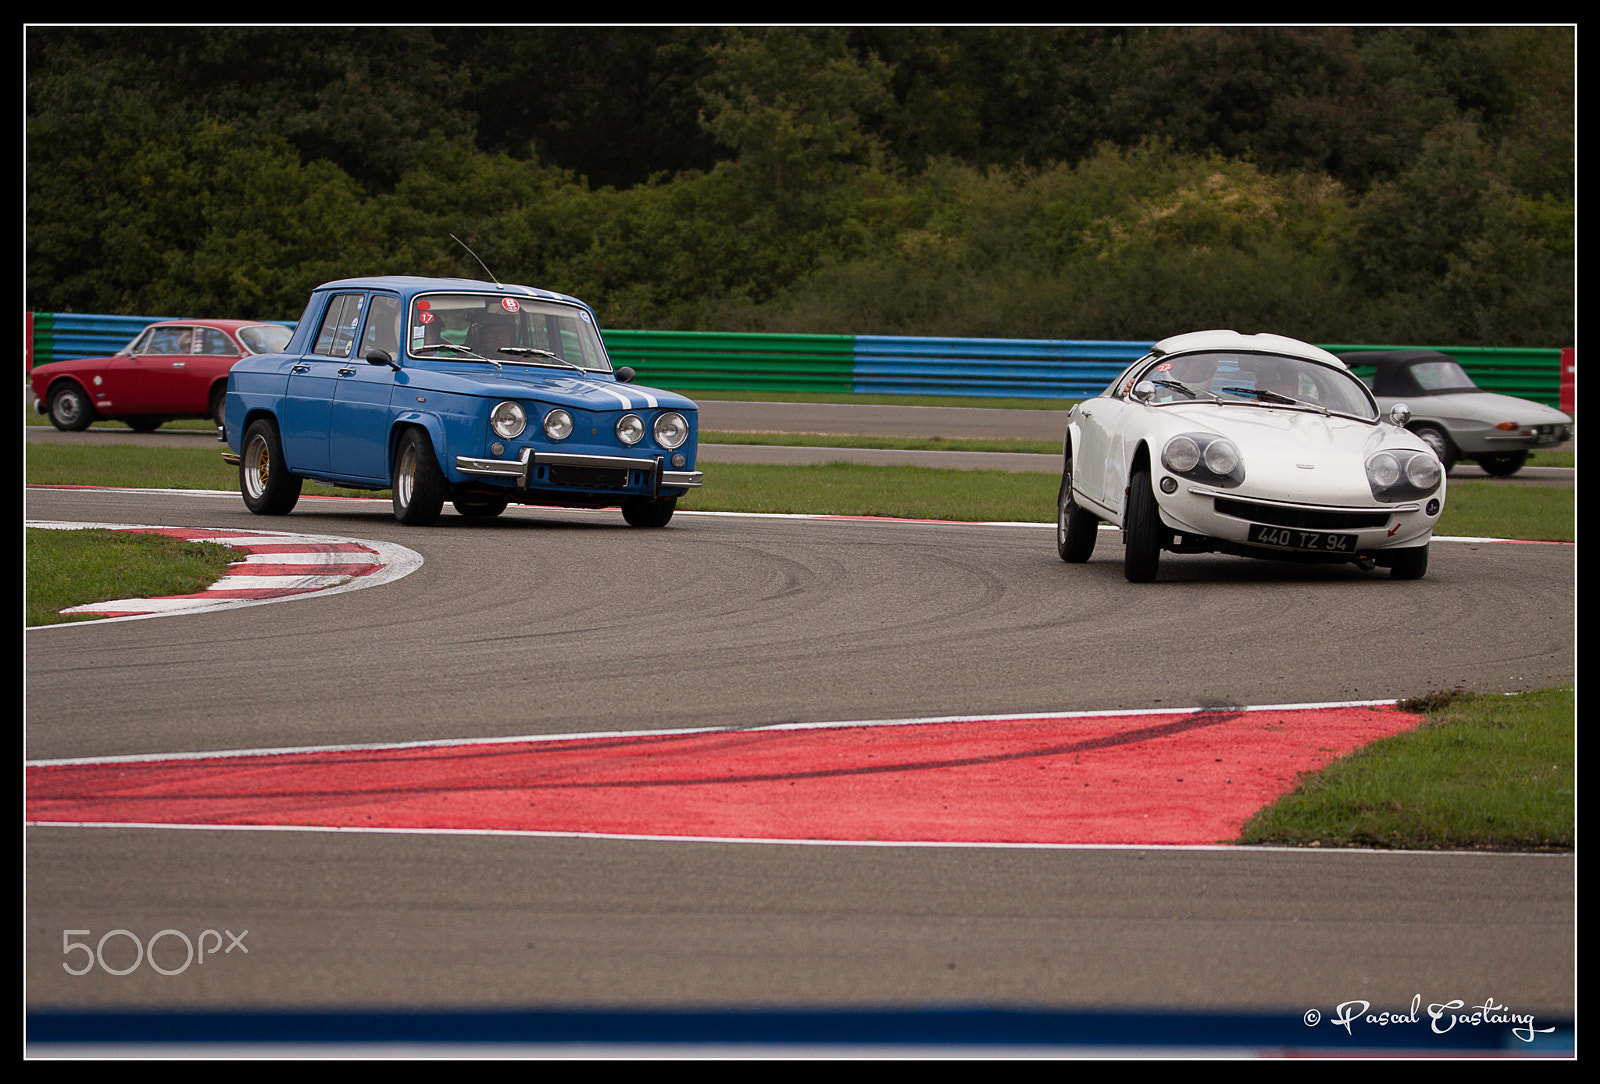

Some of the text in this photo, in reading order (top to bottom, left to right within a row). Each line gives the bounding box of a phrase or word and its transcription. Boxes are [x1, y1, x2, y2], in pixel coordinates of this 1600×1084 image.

[422, 314, 433, 322] 17
[1158, 363, 1172, 372] 22
[1257, 527, 1347, 550] 440 TZ 94
